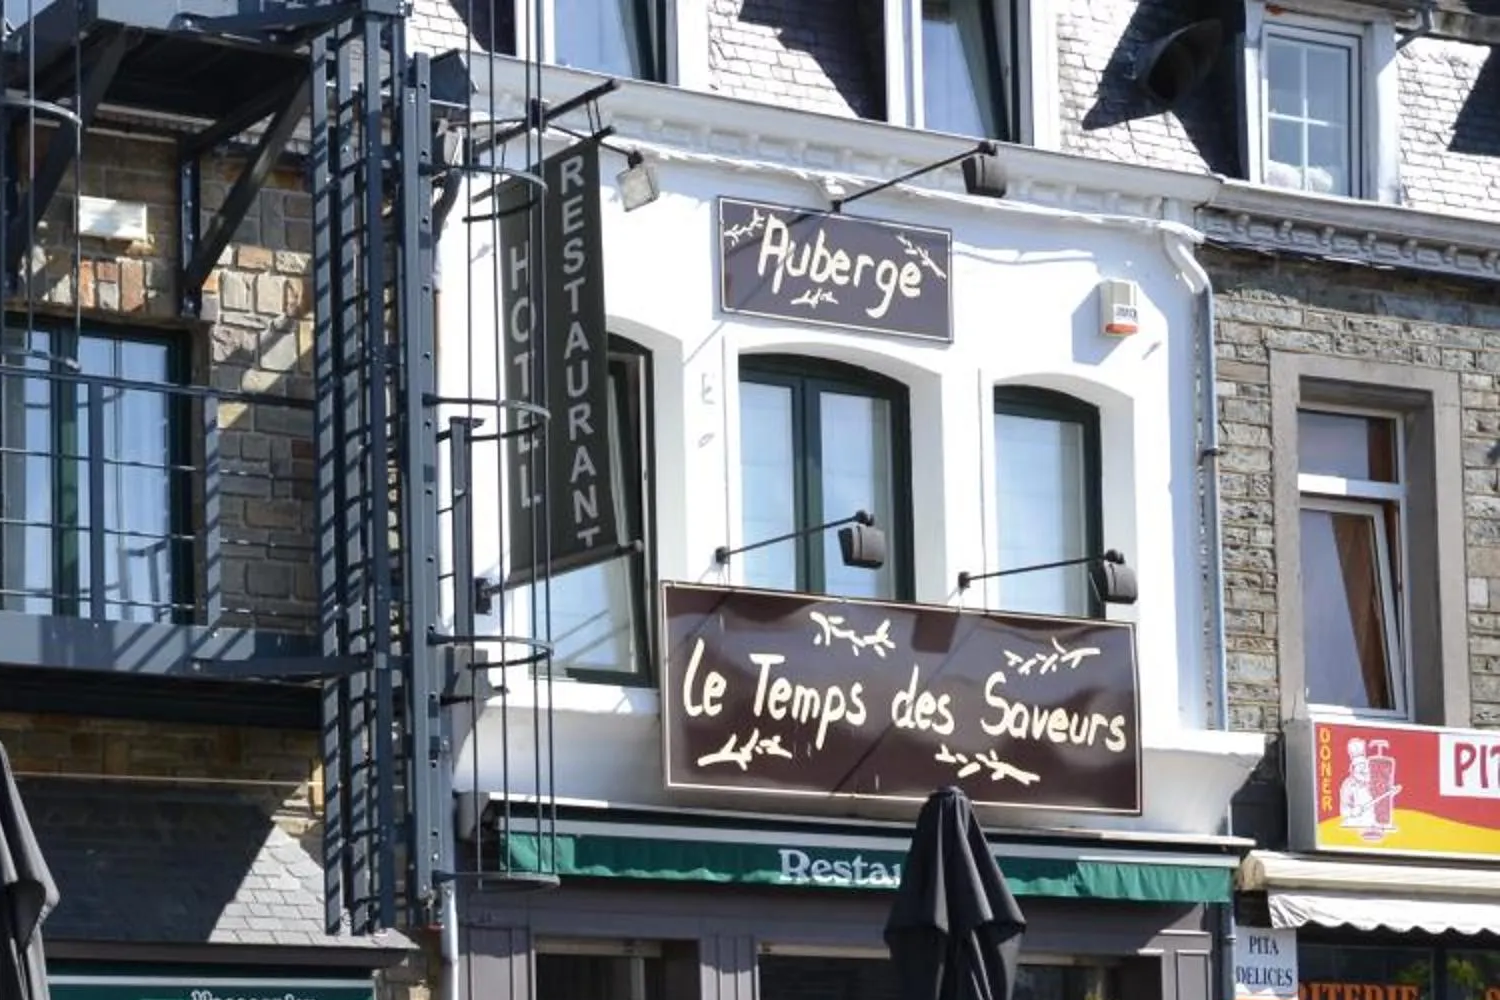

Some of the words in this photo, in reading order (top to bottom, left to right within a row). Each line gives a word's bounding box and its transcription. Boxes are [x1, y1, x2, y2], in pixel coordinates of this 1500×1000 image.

[757, 213, 922, 319] Auberge
[510, 245, 542, 508] HOTEL
[560, 153, 600, 549] RESTAURANT
[682, 638, 727, 717] Le
[749, 653, 867, 750] Temps
[891, 664, 955, 735] des
[980, 671, 1128, 752] Saveurs
[1235, 966, 1294, 987] DELICES
[1248, 935, 1280, 955] PITA
